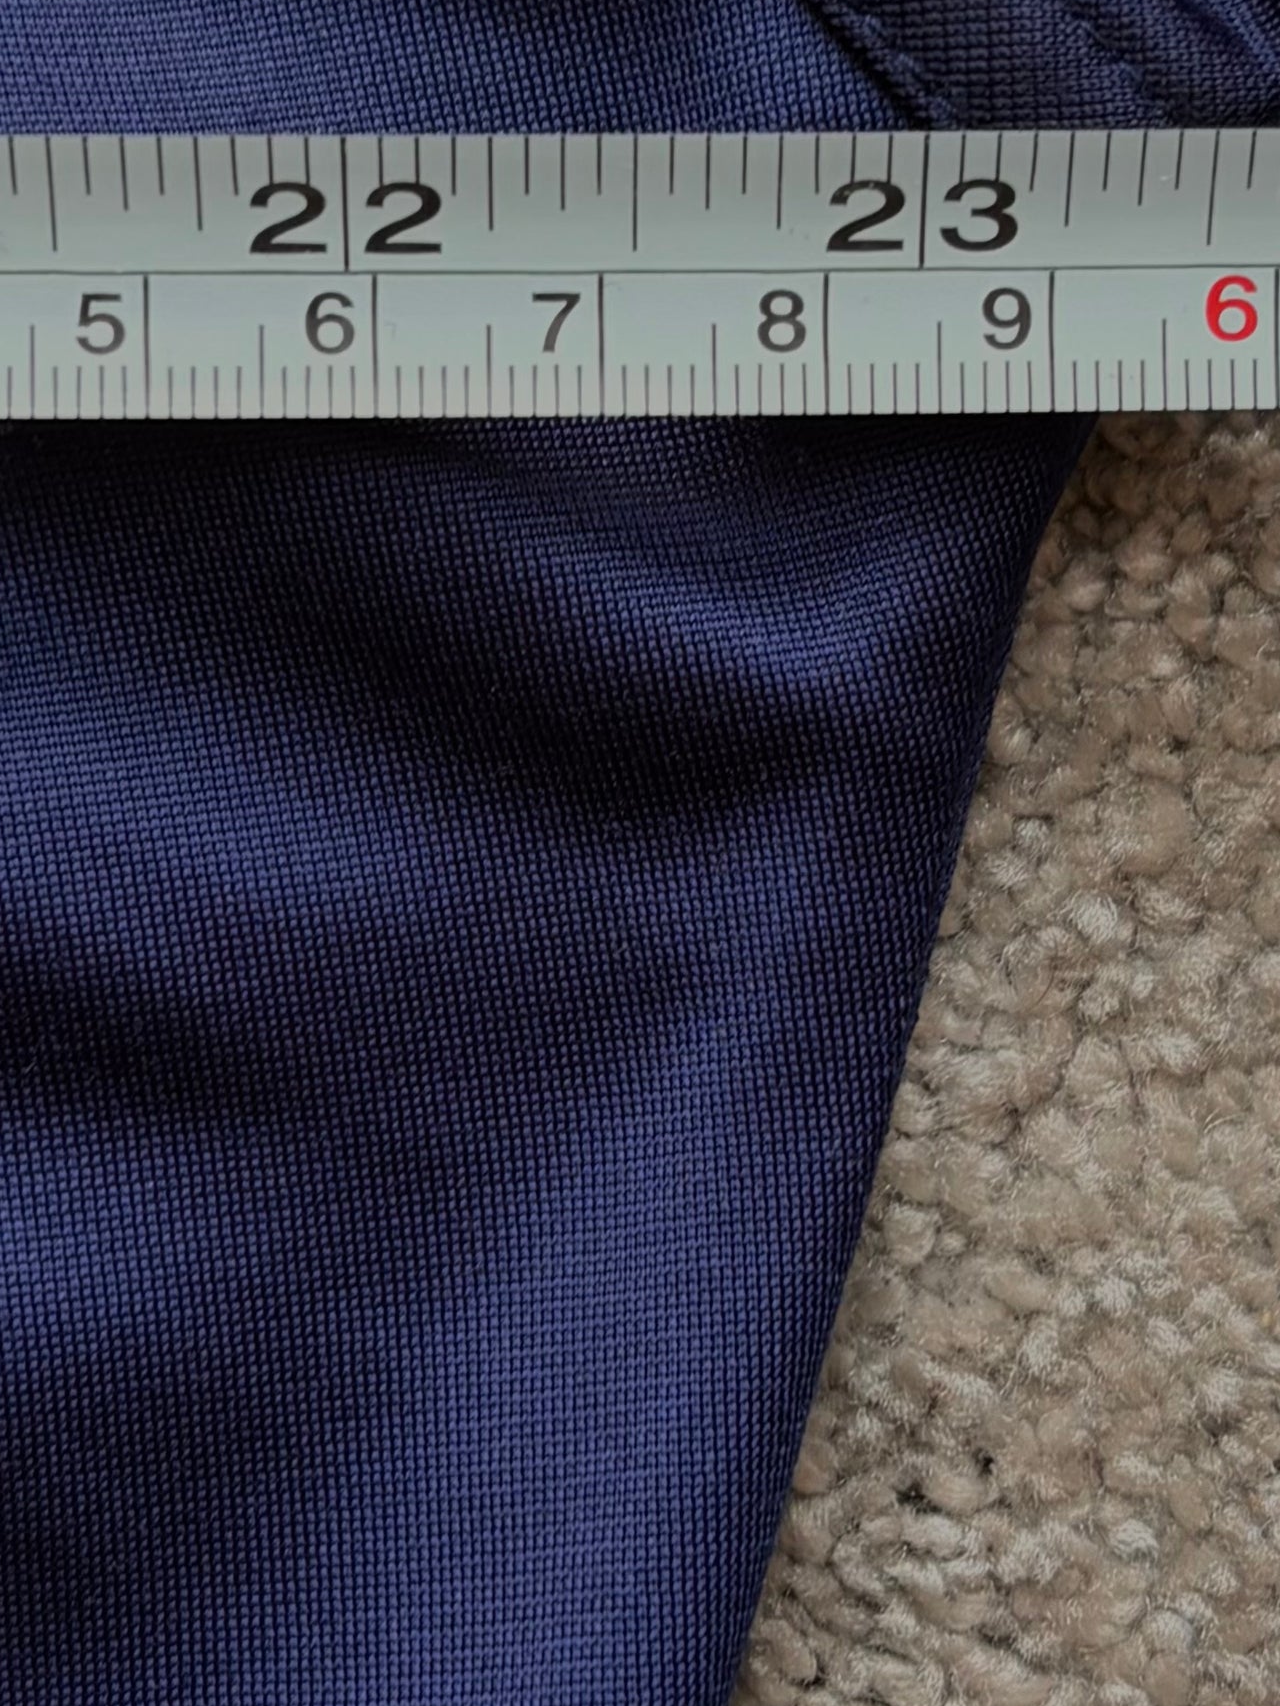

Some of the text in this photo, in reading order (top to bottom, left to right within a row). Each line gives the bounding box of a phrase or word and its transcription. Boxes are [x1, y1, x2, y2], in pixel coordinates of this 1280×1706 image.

[248, 181, 442, 255] 22
[826, 178, 1019, 252] 23
[75, 294, 123, 354] 5
[304, 293, 355, 353] 6
[532, 294, 580, 353] 7
[756, 290, 807, 351] 8
[981, 288, 1032, 350] 9
